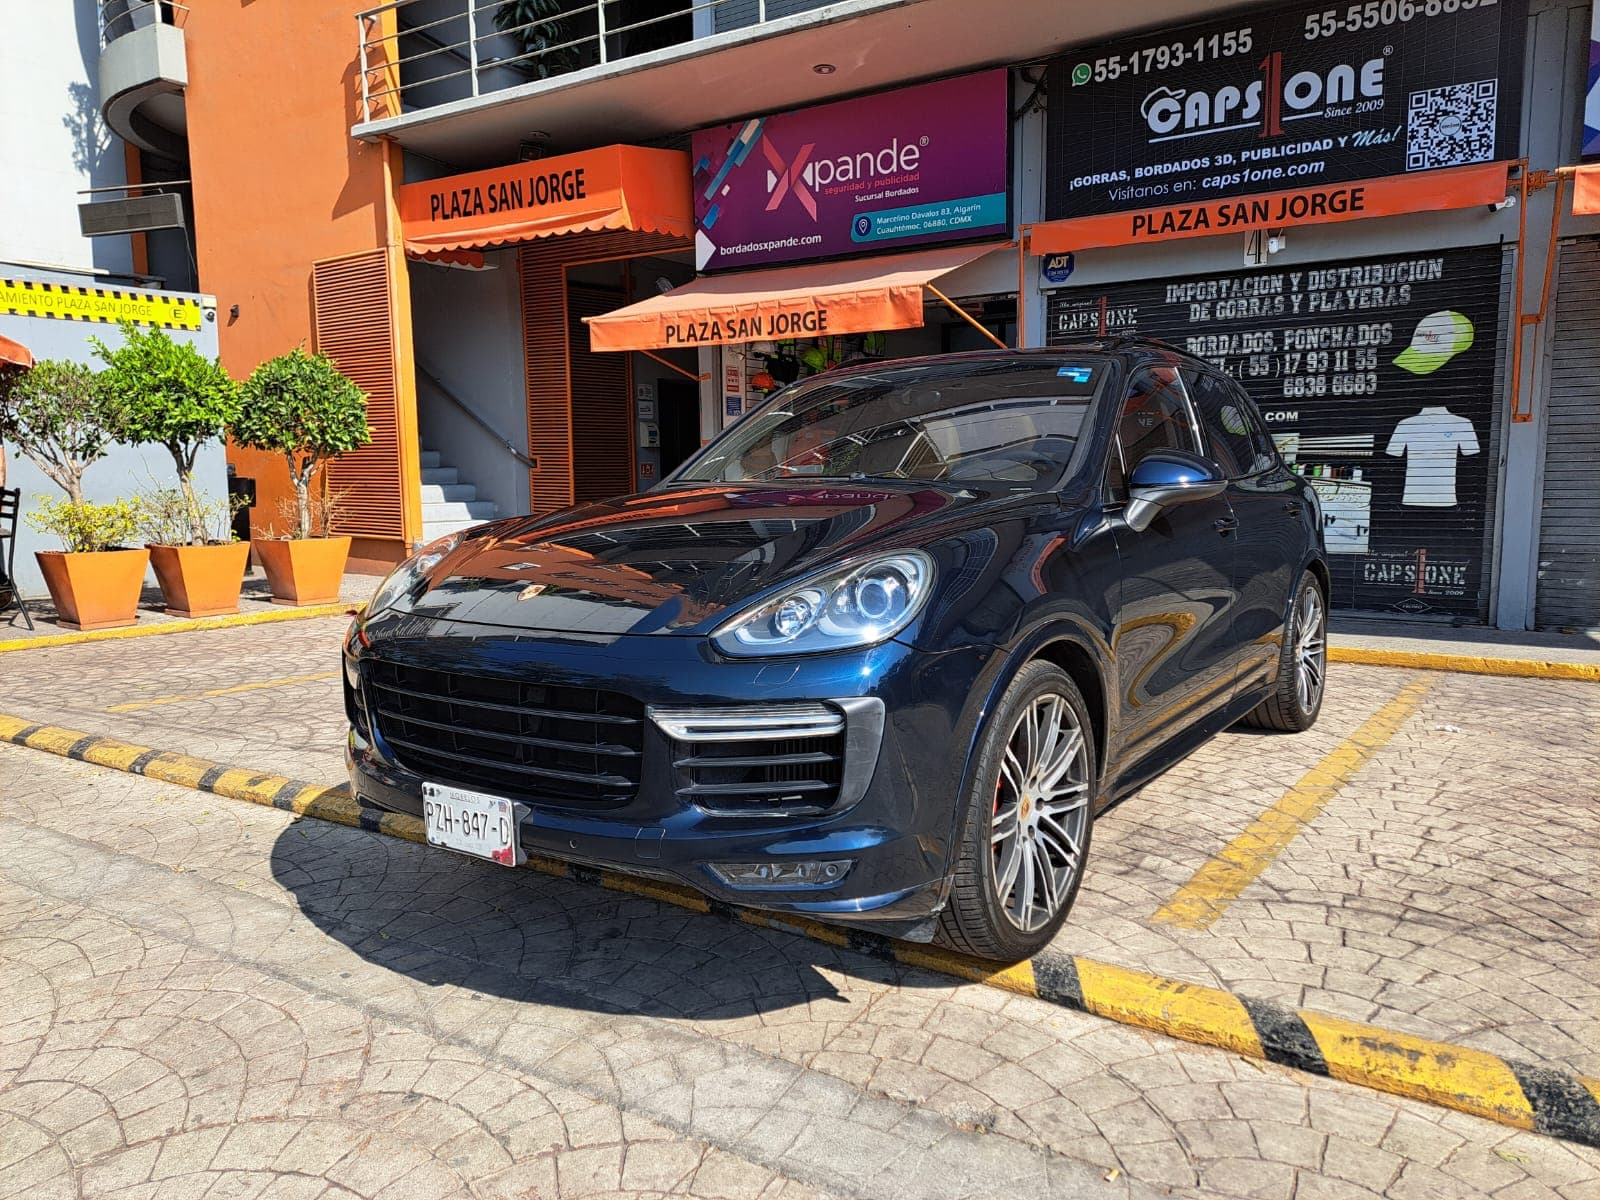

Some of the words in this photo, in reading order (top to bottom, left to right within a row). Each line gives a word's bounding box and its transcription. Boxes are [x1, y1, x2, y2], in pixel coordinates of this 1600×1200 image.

[1094, 28, 1252, 82] 55-1793-1155
[1323, 106, 1352, 118] Since
[1355, 99, 1384, 113] 2009
[1134, 157, 1210, 178] BORDADOS
[1214, 153, 1236, 166] 3D,
[1241, 139, 1333, 162] PUBLICIDAD
[1338, 136, 1348, 147] Y
[1352, 125, 1402, 147] Más!
[430, 186, 485, 221] PLAZA
[487, 180, 523, 213] SAN
[528, 168, 586, 208] JORGE
[824, 180, 865, 195] seguridad
[867, 181, 872, 190] y
[874, 172, 920, 189] publicidad
[855, 192, 884, 203] Sucursal
[885, 186, 920, 198] Bordados
[1109, 182, 1169, 201] Visítanos
[1173, 178, 1197, 192] en:
[1202, 161, 1325, 189] caps1one.com
[876, 214, 910, 225] Marcelino
[949, 215, 972, 224] CDMX
[1132, 208, 1210, 236] PLAZA
[1217, 199, 1269, 227] SAN
[1275, 187, 1365, 221] JORGE
[720, 235, 822, 255] bordadosxpande.com
[1048, 255, 1069, 269] ADT
[1166, 274, 1284, 303] IMPORTACION
[1290, 272, 1302, 291] Y
[1307, 258, 1443, 291] DISTRIBUCION
[57, 298, 91, 311] PLAZA
[94, 302, 116, 313] SAN
[119, 304, 152, 316] JORGE
[1189, 302, 1211, 322] DE
[1215, 296, 1285, 320] GORRAS
[1291, 294, 1303, 313] Y
[1308, 284, 1411, 312] PLAYERAS
[665, 320, 722, 344] PLAZA
[727, 316, 762, 339] SAN
[768, 309, 827, 335] JORGE
[1283, 322, 1393, 350] PONCHADOS
[1306, 351, 1328, 373] 93
[1333, 350, 1348, 371] 11
[1354, 348, 1377, 370] 55
[425, 801, 509, 845] PZH-847-D
